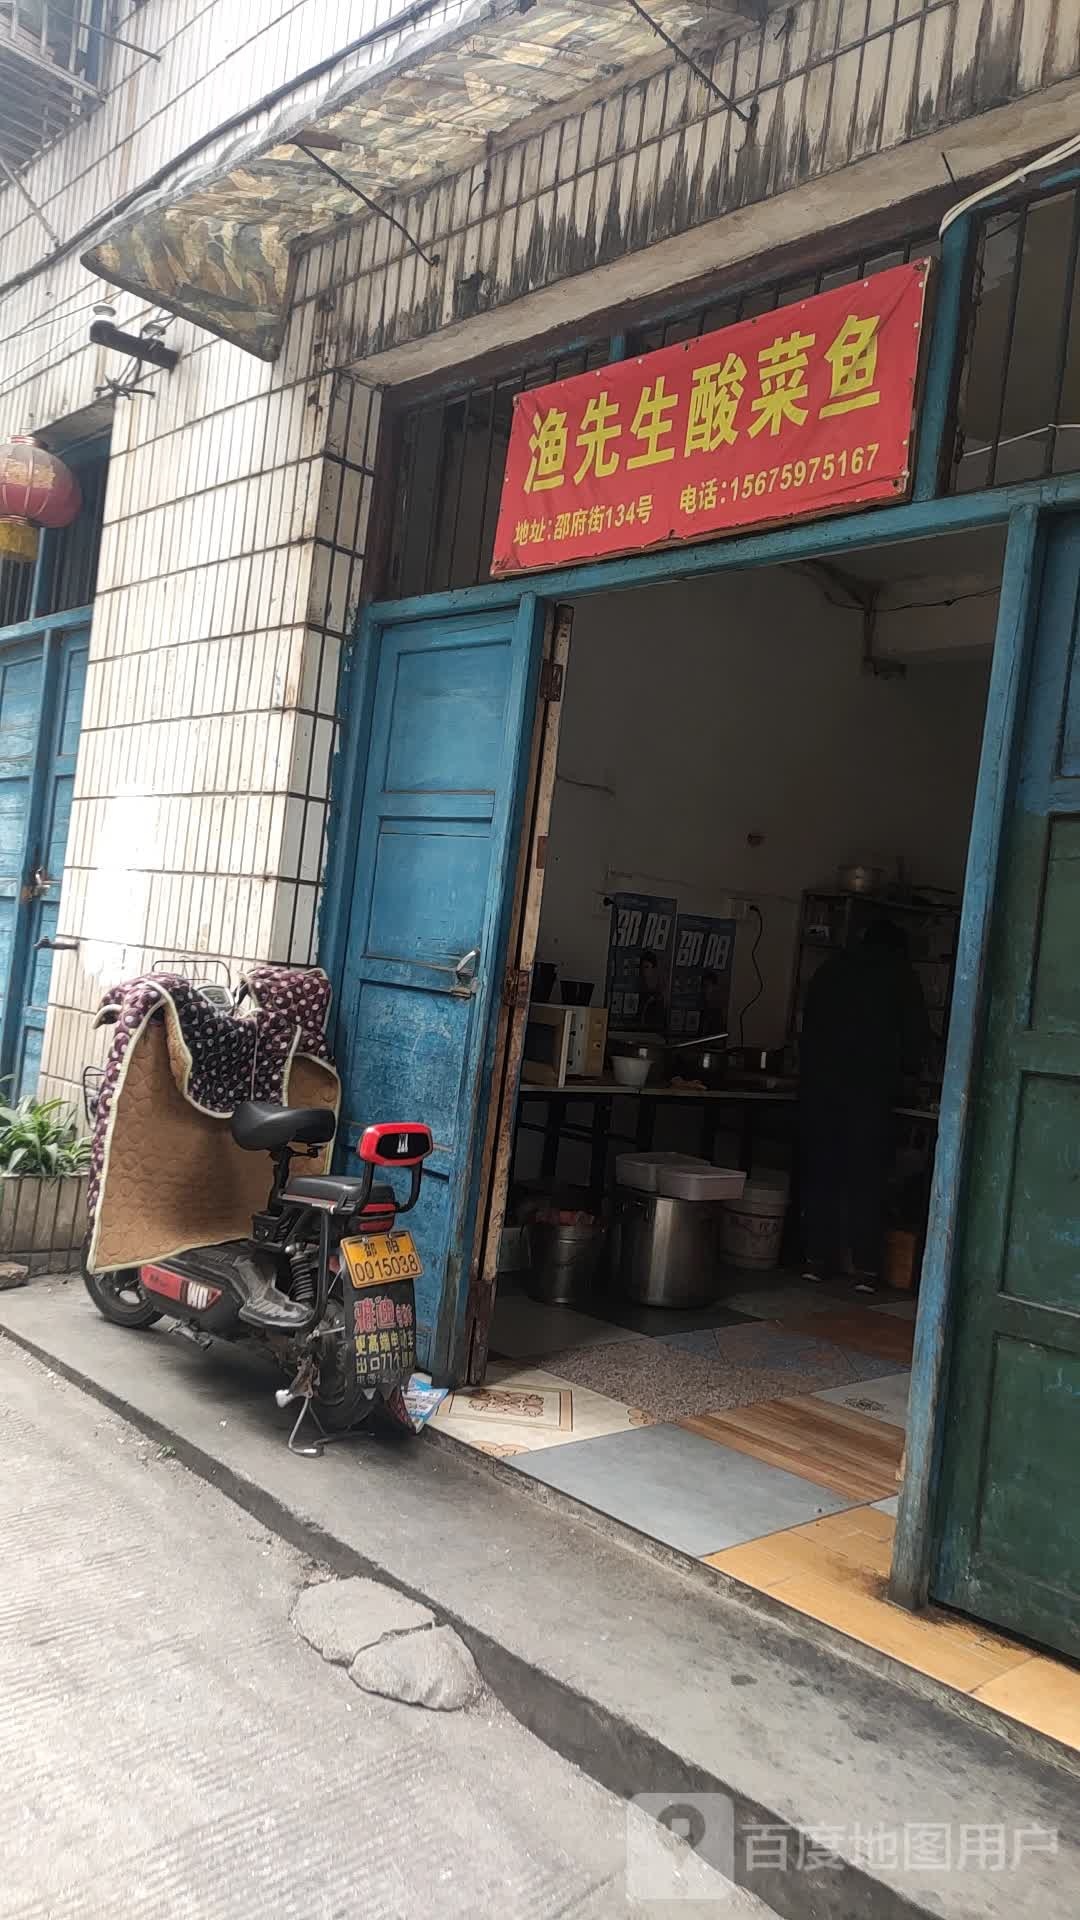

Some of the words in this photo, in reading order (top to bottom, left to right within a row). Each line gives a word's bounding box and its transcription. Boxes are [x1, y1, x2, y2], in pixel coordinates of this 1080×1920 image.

[522, 314, 881, 494] 渔先生酸菜鱼
[354, 1254, 418, 1282] 0015038
